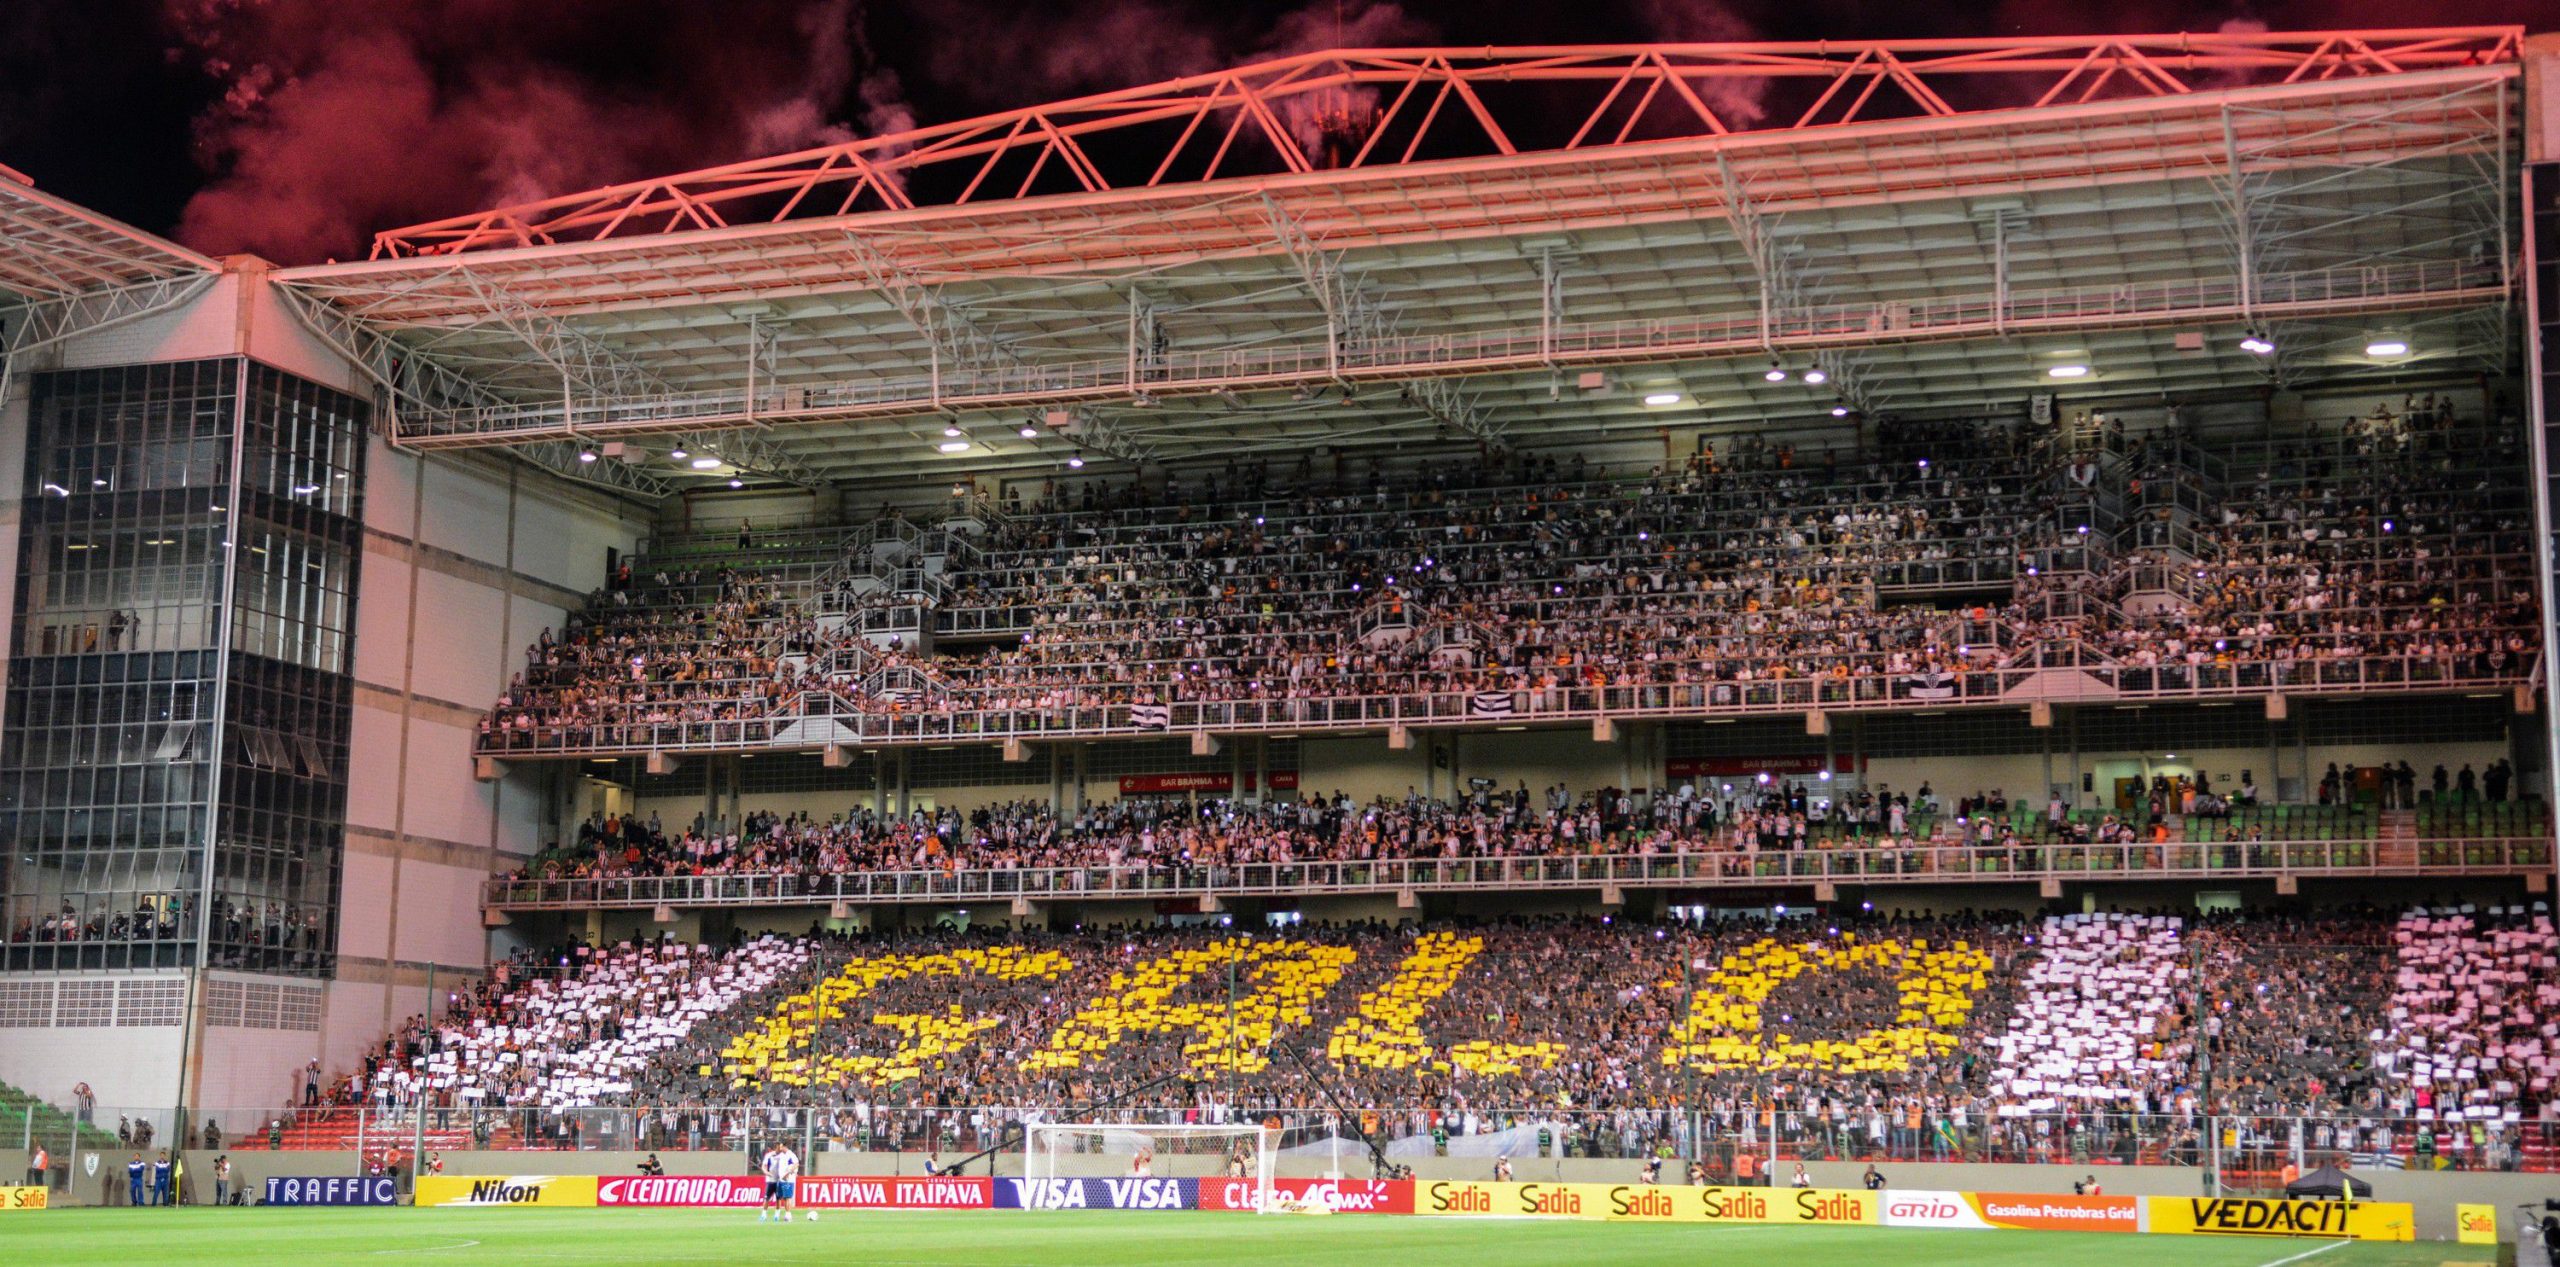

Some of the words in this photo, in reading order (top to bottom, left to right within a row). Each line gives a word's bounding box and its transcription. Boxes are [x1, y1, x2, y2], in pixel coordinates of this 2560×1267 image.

[1161, 779, 1177, 787] BAR
[1177, 777, 1213, 787] BRAHMA
[1218, 777, 1228, 785] 14
[698, 930, 1994, 1078] GALO
[14, 1188, 46, 1207] Sadia
[267, 1178, 394, 1203] TRAFFIC
[470, 1180, 540, 1203] Nikon
[627, 1178, 776, 1204] CENTAURO.com.
[802, 1183, 887, 1204] ITAIPAVA
[896, 1183, 983, 1204] ITAIPAVA
[1009, 1178, 1086, 1209] VISA
[1103, 1178, 1182, 1209] VISA
[1225, 1182, 1294, 1209] Claro
[1431, 1182, 1490, 1211] Sadia
[1520, 1184, 1580, 1214] Sadia
[1610, 1186, 1672, 1216] Sadia
[1703, 1188, 1766, 1219] Sadia
[1797, 1190, 1861, 1221] Sadia
[1889, 1198, 1959, 1219] GRID
[1987, 1203, 2041, 1218] Gasolina
[2044, 1206, 2106, 1219] Petrobras
[2108, 1206, 2136, 1220] Grid
[2191, 1198, 2361, 1232] VEDACIT
[2461, 1212, 2493, 1233] Sadia
